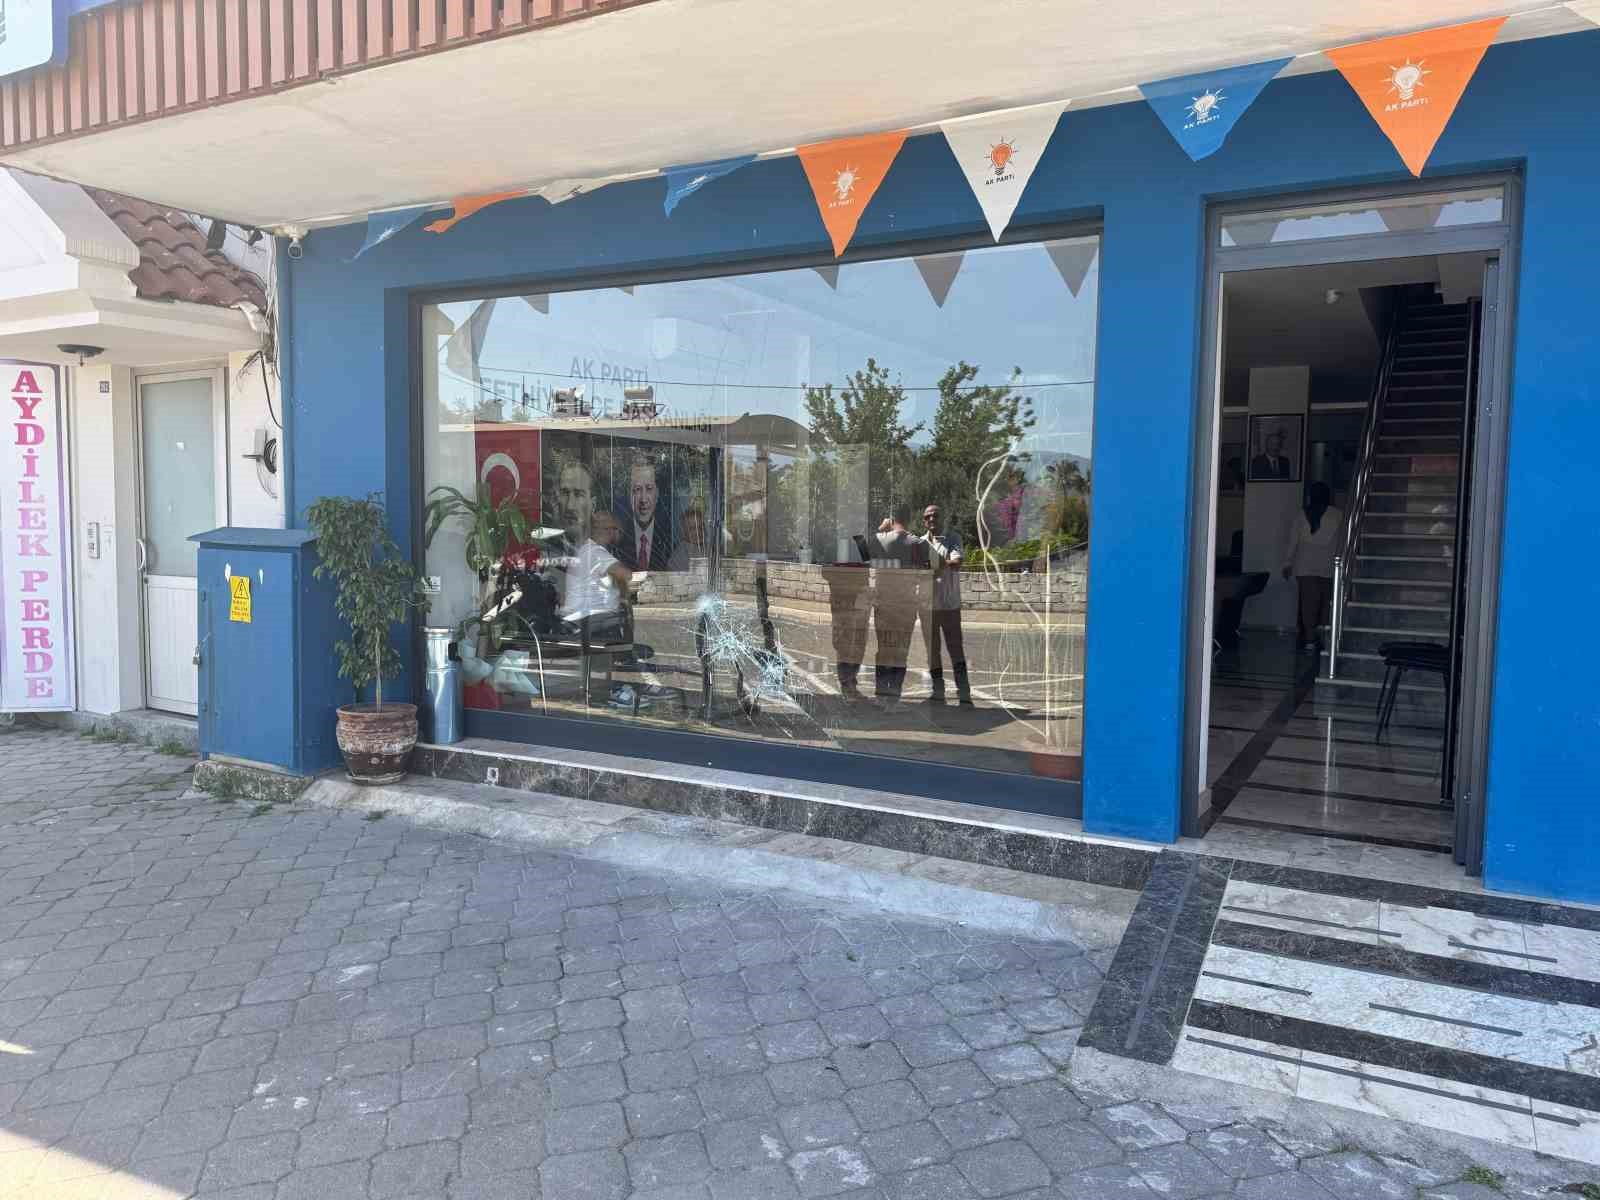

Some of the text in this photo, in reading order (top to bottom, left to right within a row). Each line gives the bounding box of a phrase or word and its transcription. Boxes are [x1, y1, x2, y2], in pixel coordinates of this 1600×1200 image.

[1384, 103, 1399, 112] AK
[570, 356, 594, 380] AK
[11, 370, 54, 698] AYDİLEK PERDE
